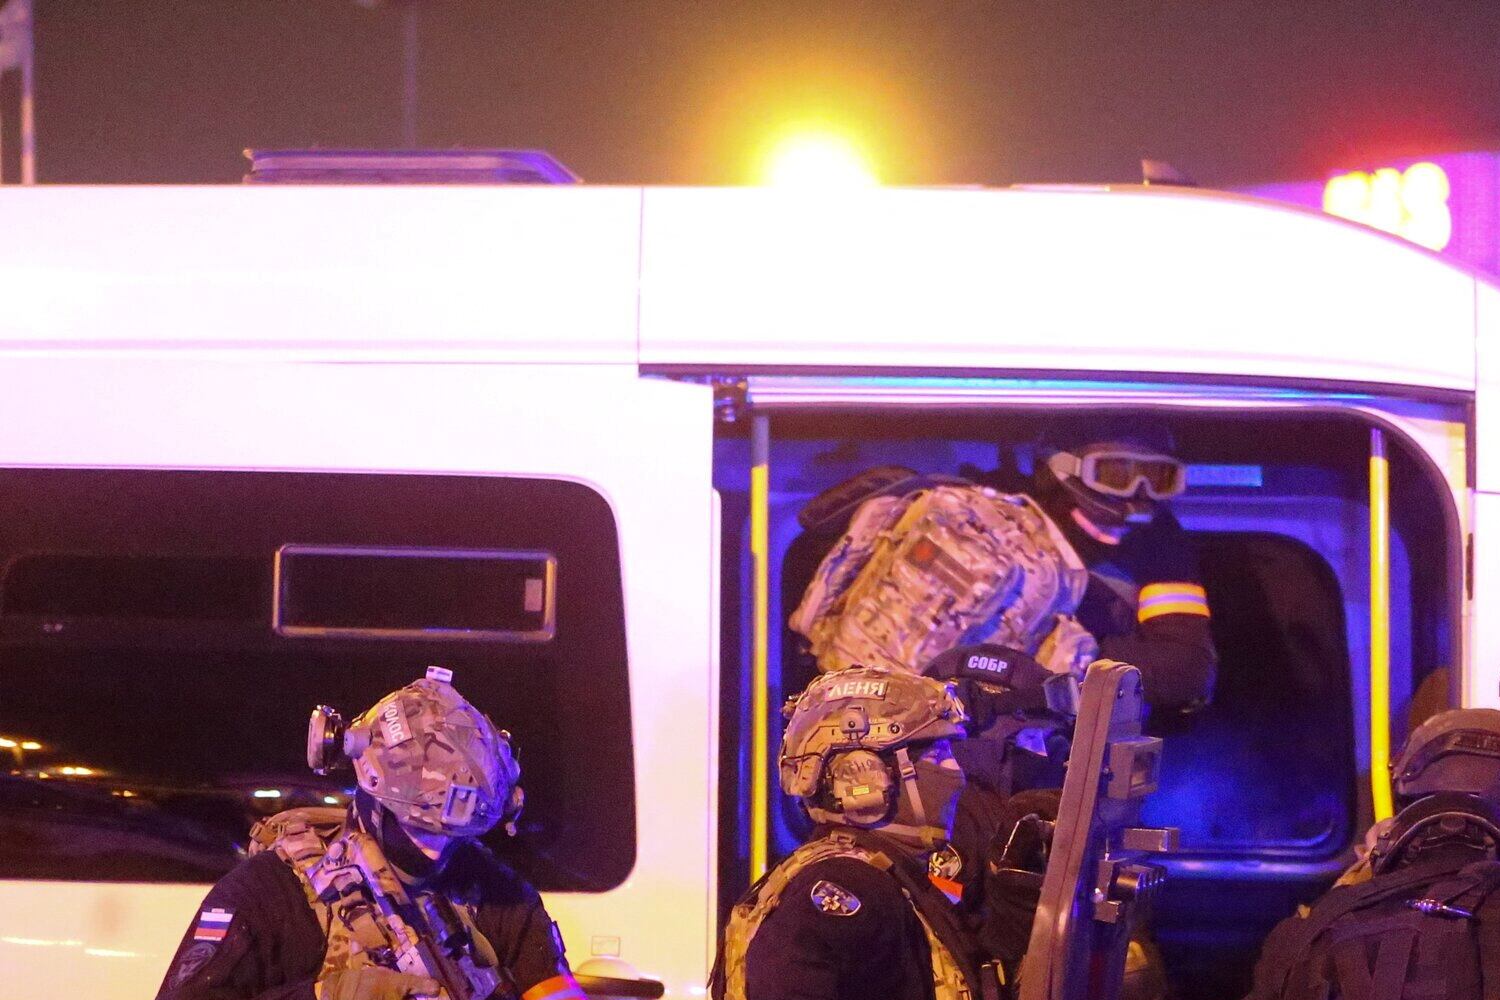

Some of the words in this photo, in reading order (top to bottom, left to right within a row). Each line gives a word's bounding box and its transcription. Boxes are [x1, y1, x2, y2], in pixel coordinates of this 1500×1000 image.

[967, 655, 1008, 673] СОБР
[828, 681, 885, 698] ЛЕНЯ
[384, 701, 405, 742] КОЛОС
